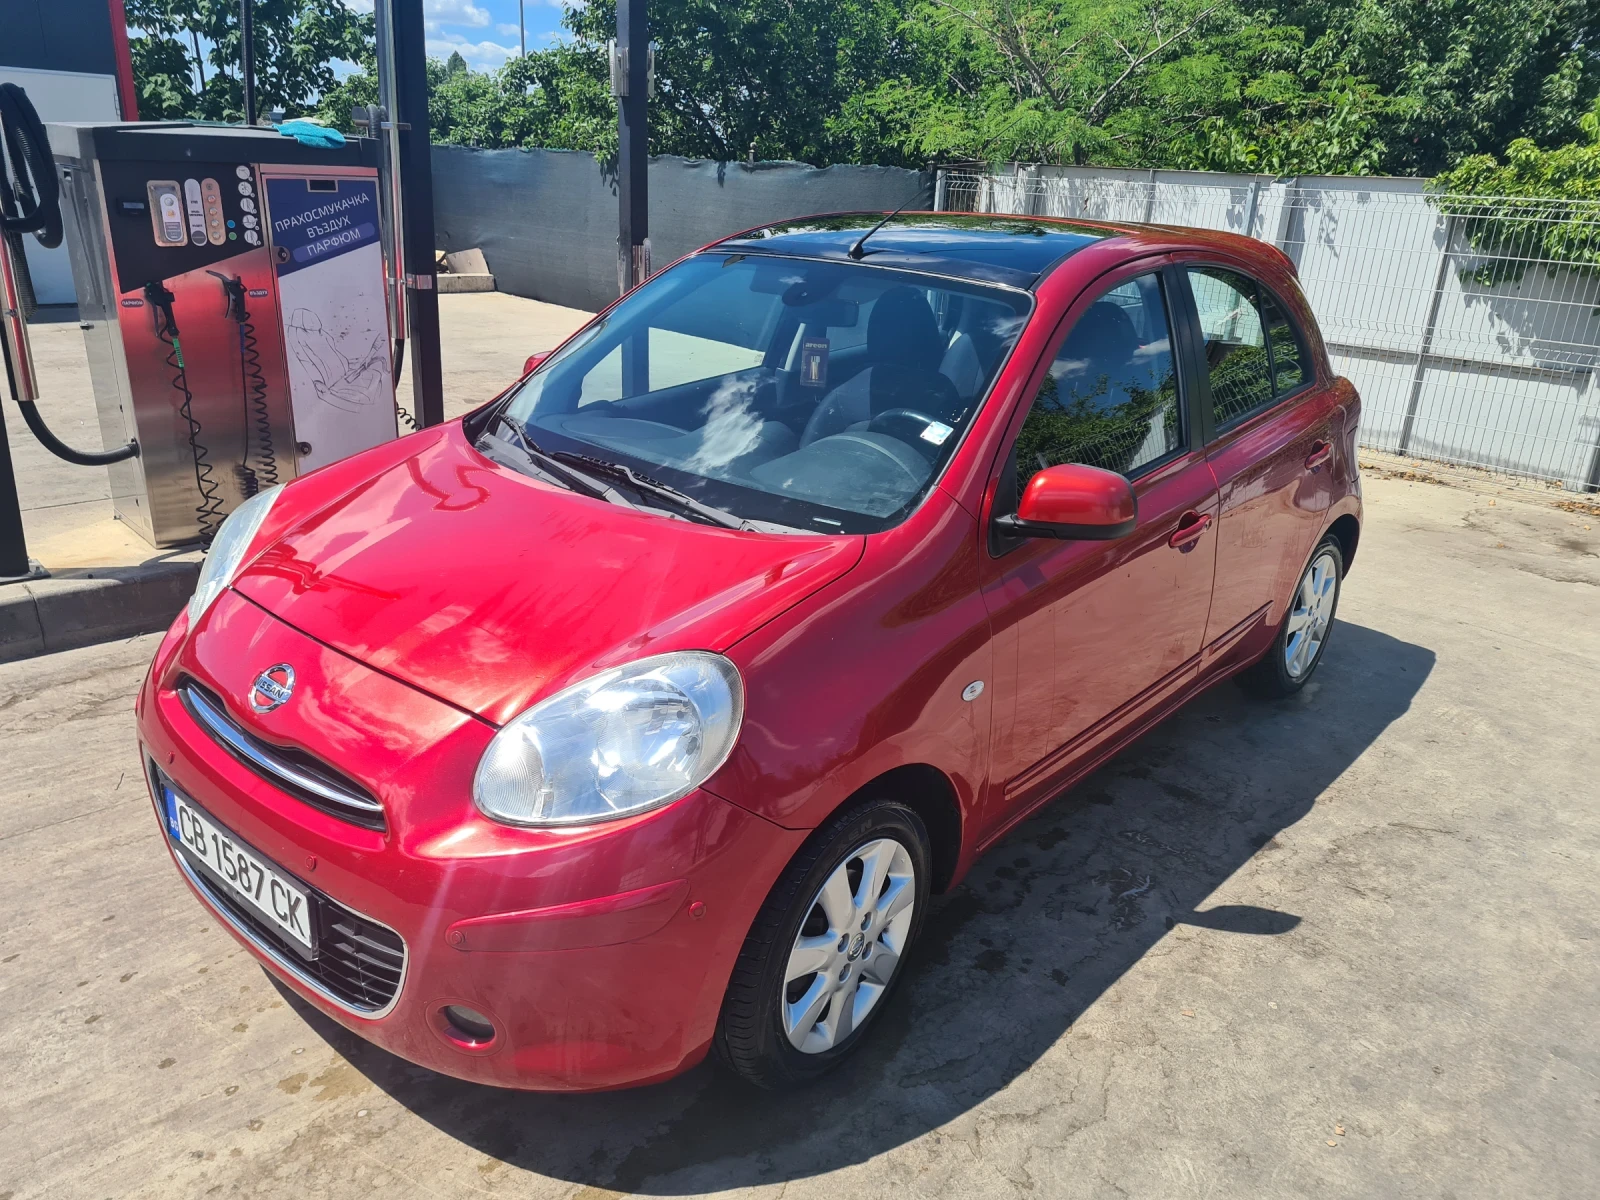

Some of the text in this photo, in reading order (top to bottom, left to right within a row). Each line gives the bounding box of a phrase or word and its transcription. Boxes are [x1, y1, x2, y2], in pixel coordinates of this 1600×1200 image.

[275, 192, 370, 232] ПРАХОСМУКАЧКА
[306, 215, 351, 238] ВЪЗДУХ
[306, 228, 361, 256] ПАРФЮМ
[256, 678, 285, 699] NISSAN
[170, 816, 179, 832] BG
[179, 805, 306, 939] CB 1587 CK
